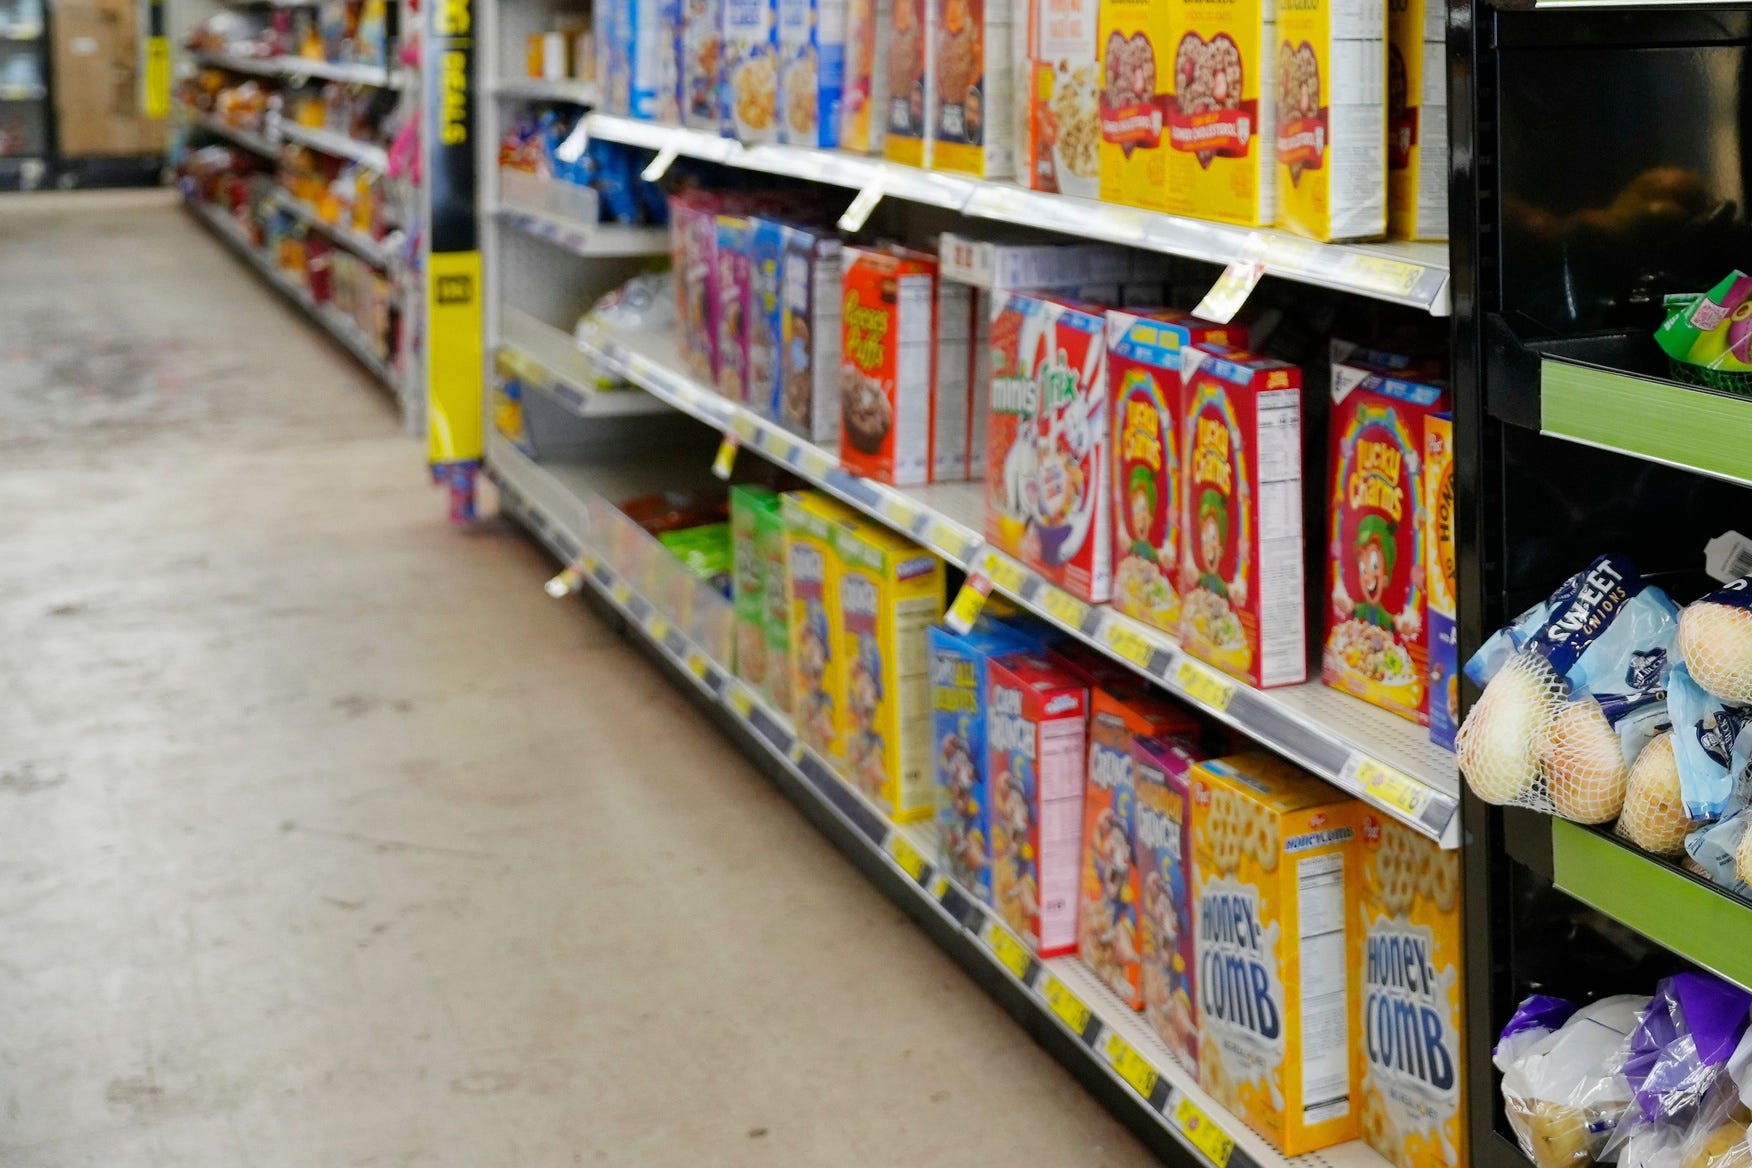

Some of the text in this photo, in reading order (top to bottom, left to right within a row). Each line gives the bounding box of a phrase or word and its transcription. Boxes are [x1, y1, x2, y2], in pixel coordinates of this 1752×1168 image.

[1357, 437, 1400, 484] Lucky
[1350, 472, 1404, 522] Charms
[1548, 559, 1623, 642] SWEET
[1582, 586, 1626, 635] ONIONS
